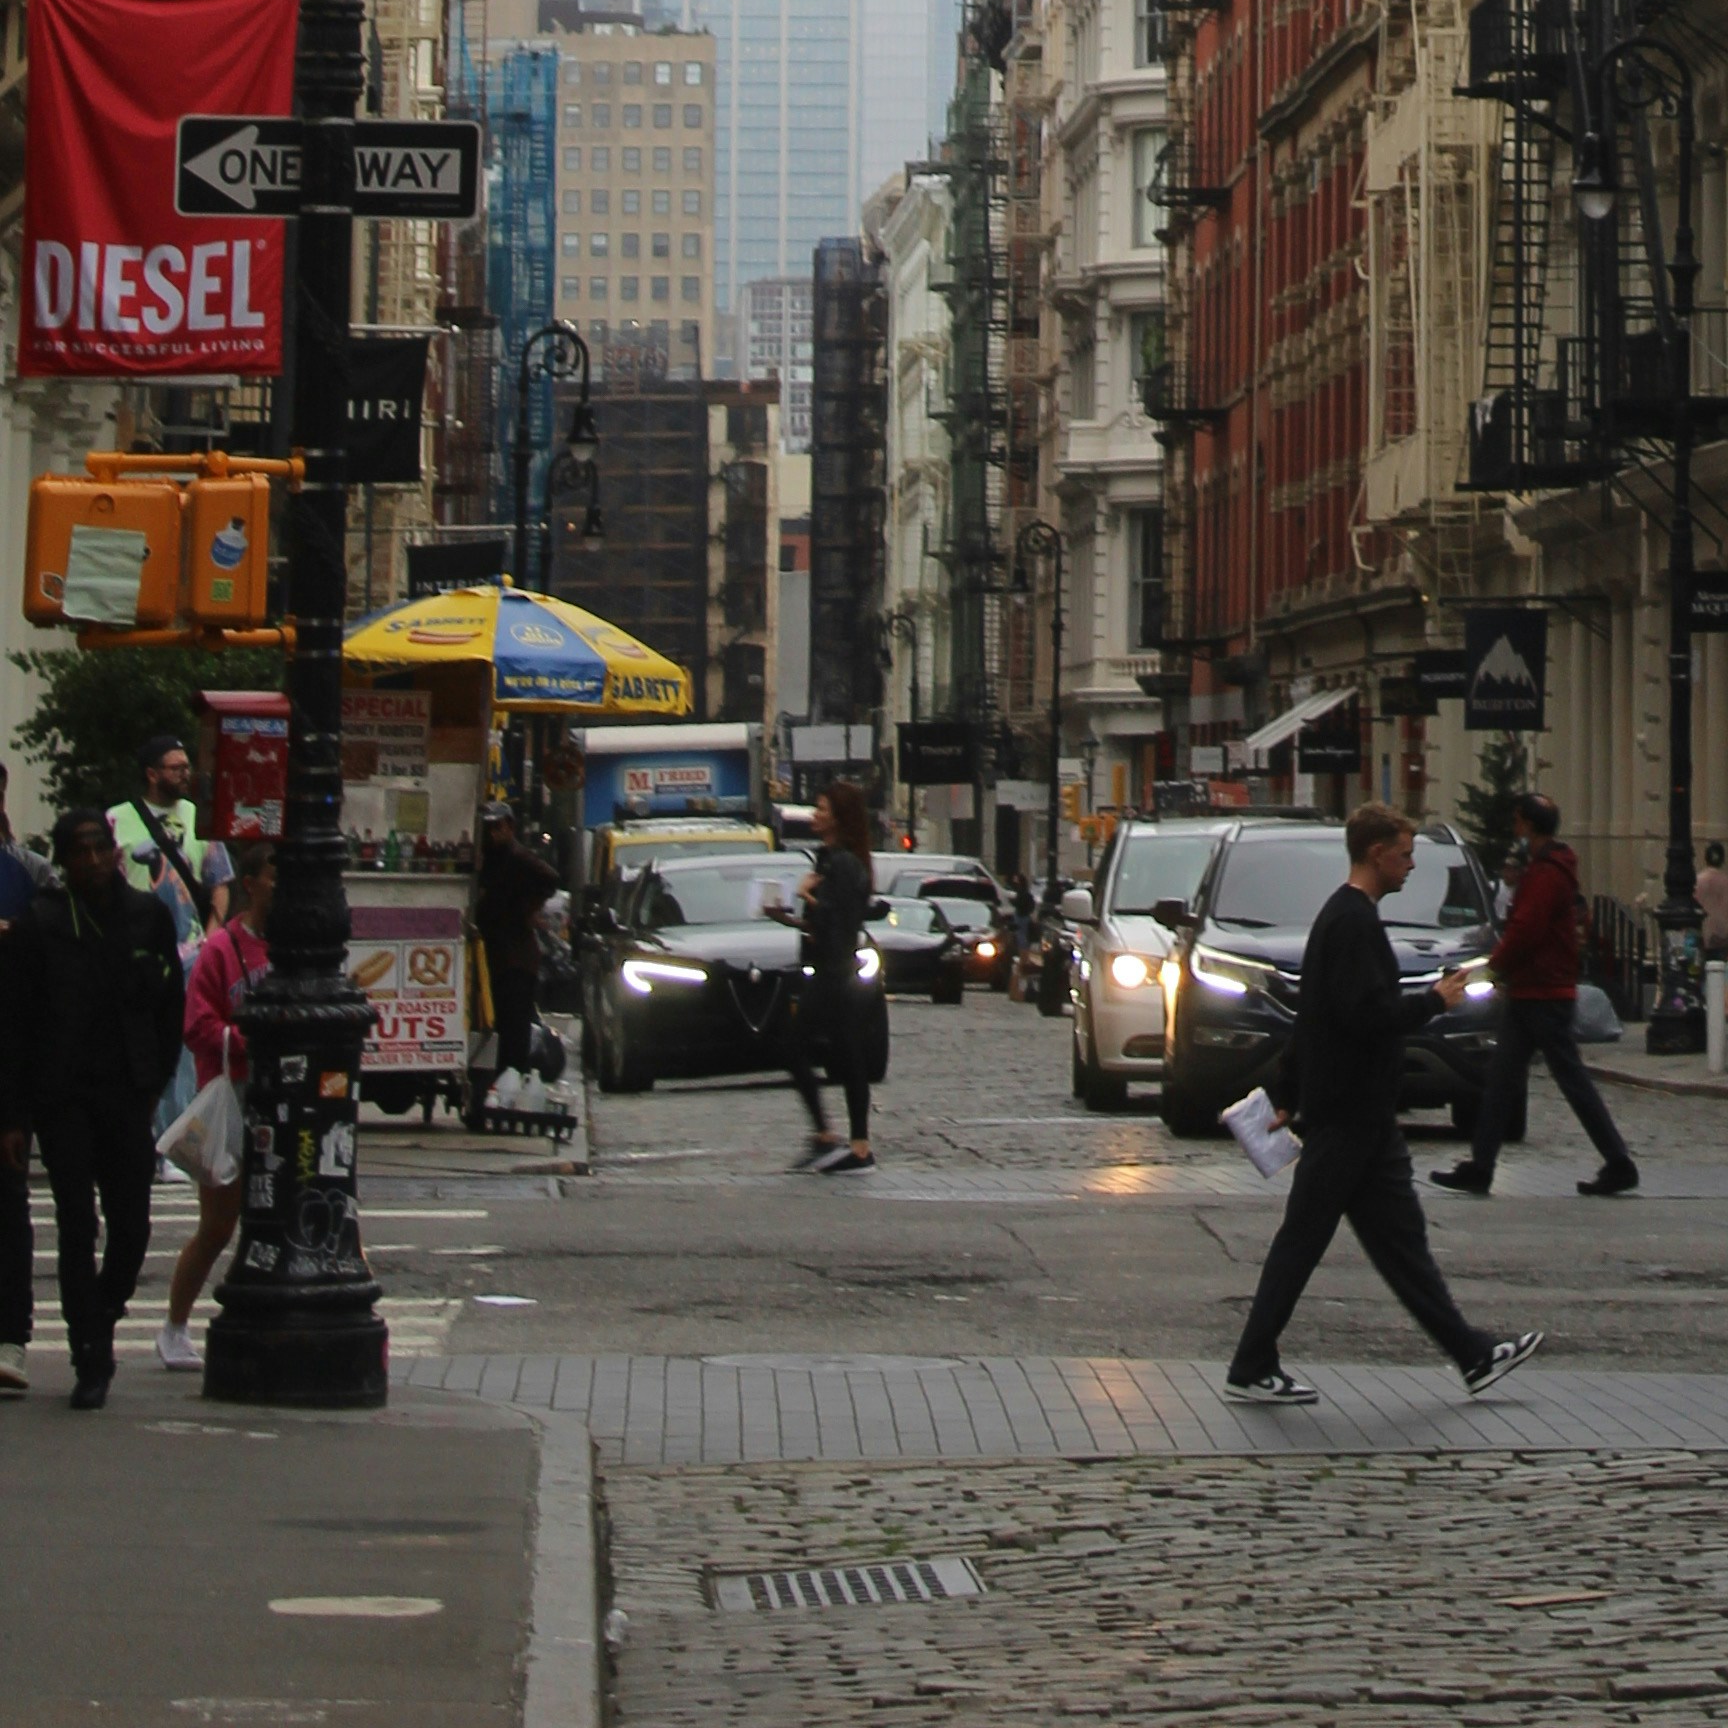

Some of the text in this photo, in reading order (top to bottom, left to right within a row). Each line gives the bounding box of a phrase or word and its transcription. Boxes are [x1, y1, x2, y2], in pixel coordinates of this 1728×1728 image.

[219, 149, 450, 187] ONE WAY
[34, 239, 266, 334] DIESEL
[72, 341, 193, 355] SUCCESSFUL
[200, 338, 265, 352] LIVING
[341, 695, 427, 717] SPECIAL
[397, 1001, 457, 1014] ROASTED
[366, 1016, 446, 1040] UTS
